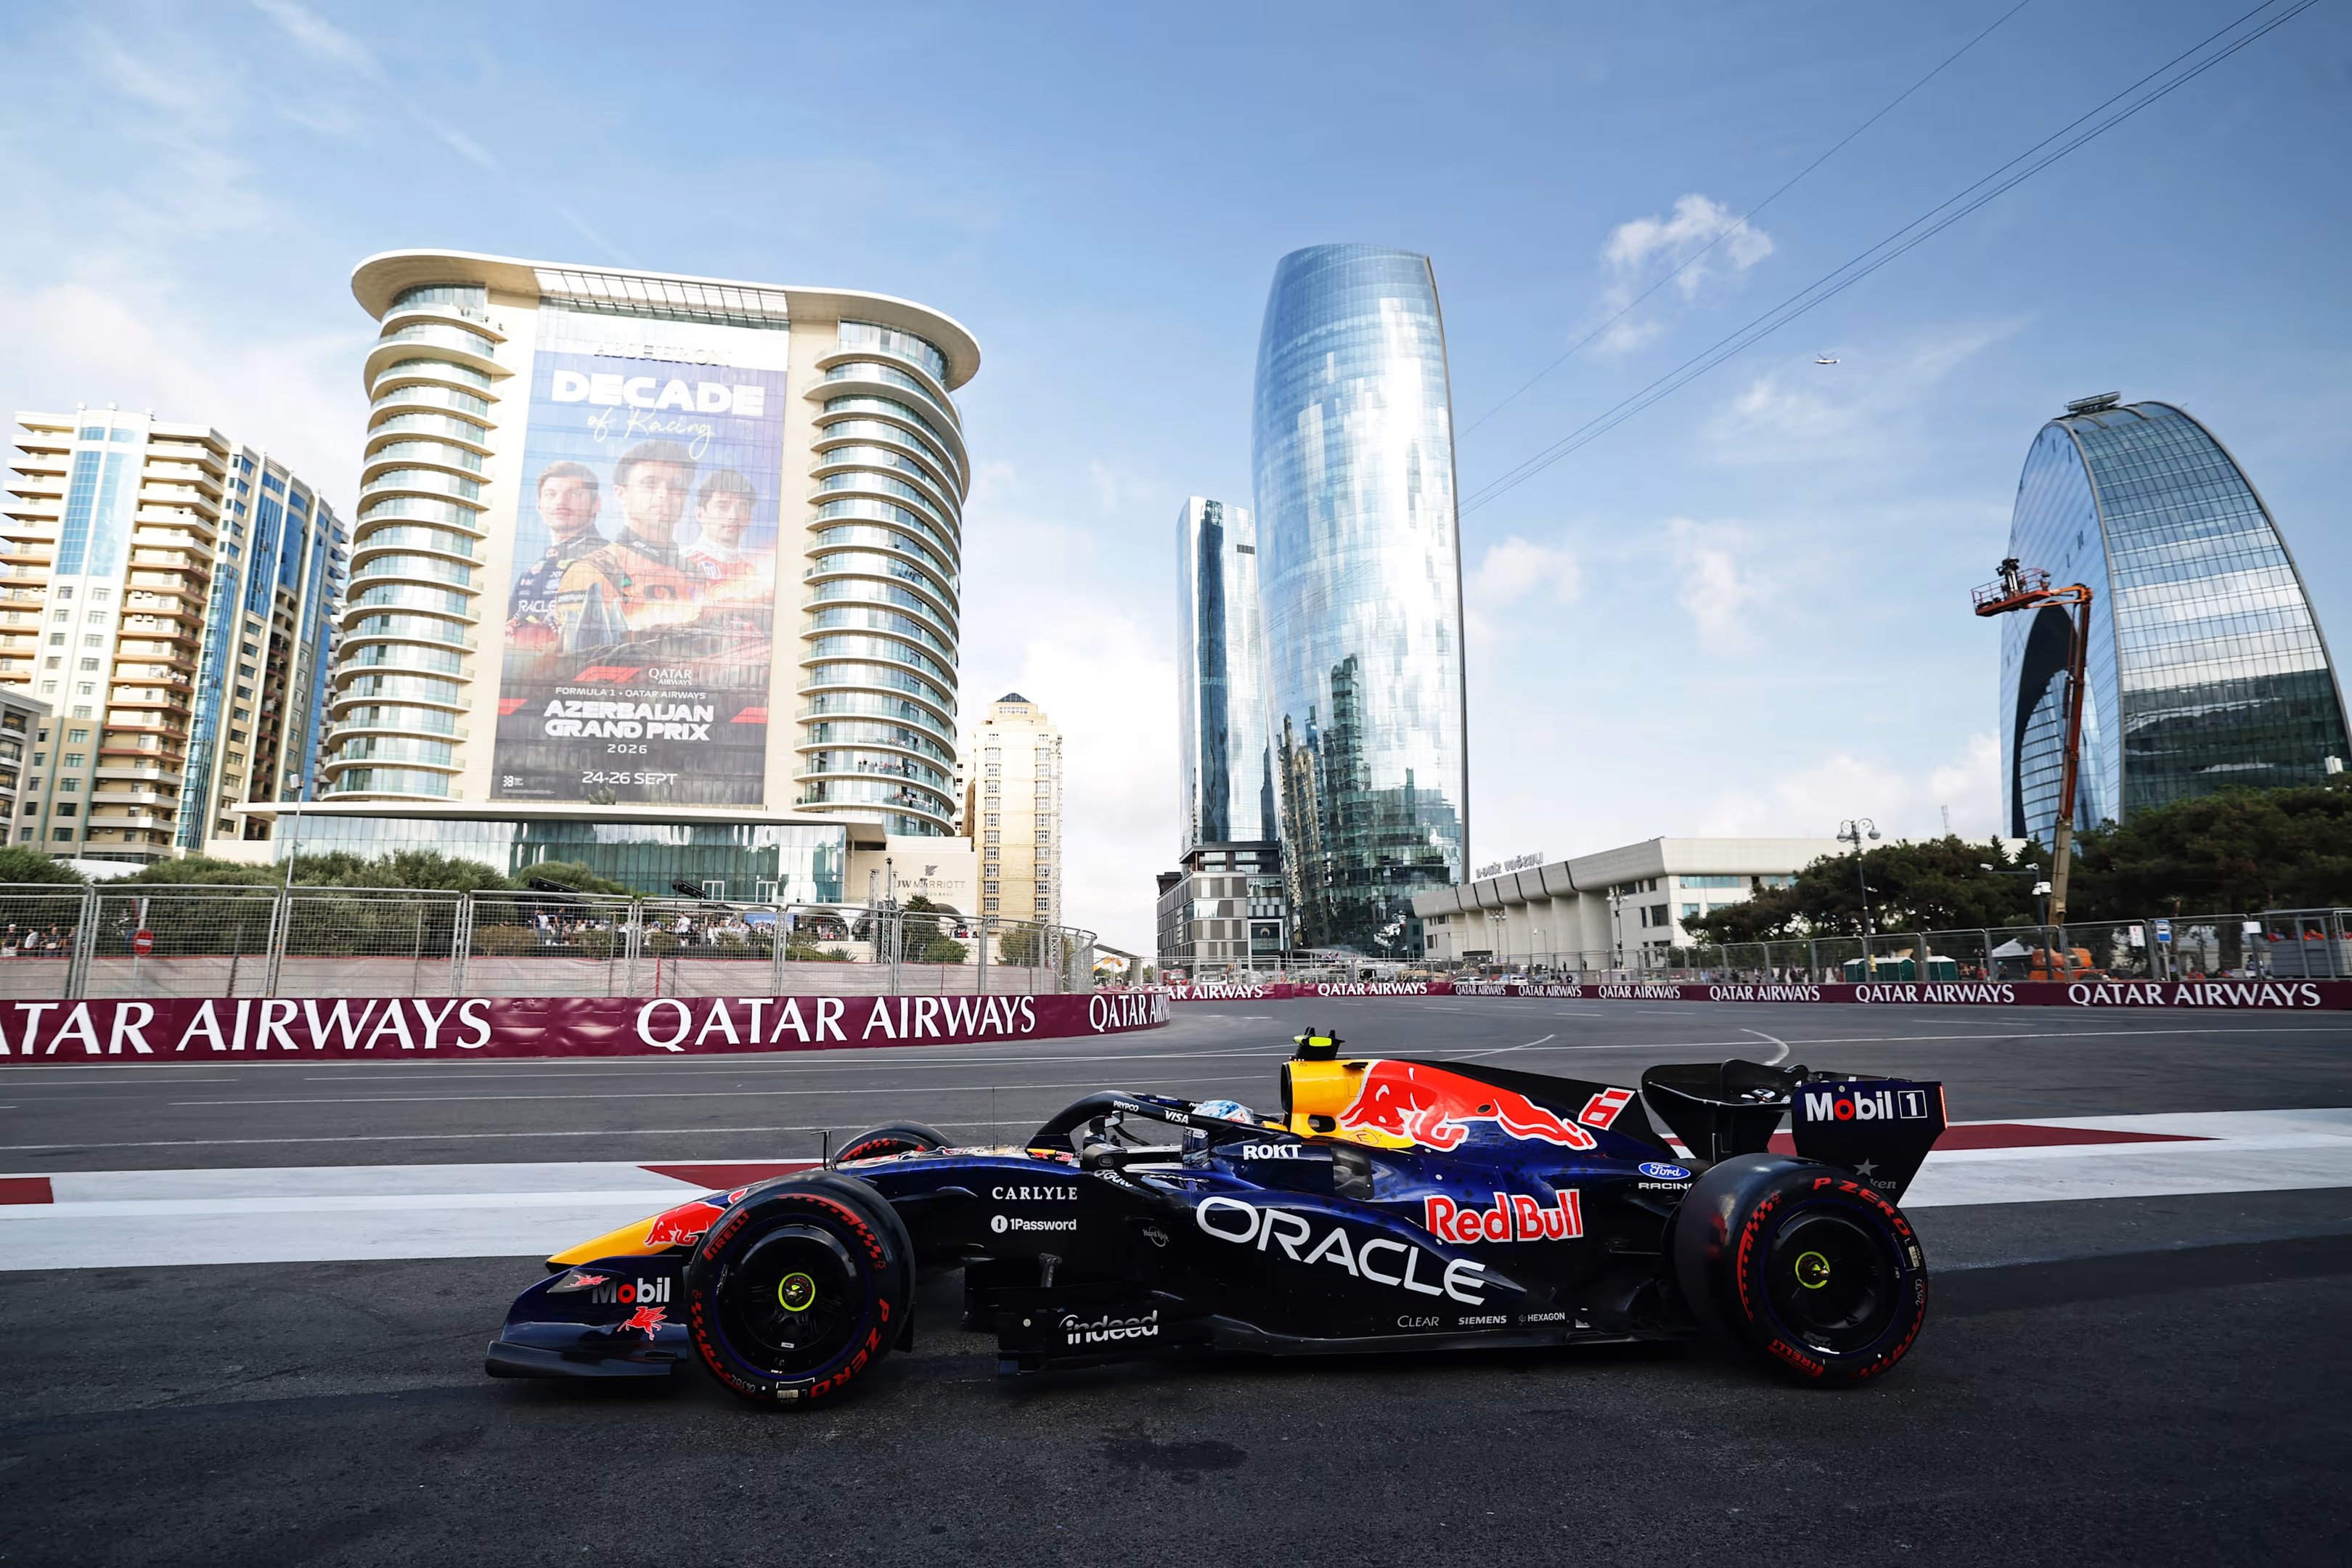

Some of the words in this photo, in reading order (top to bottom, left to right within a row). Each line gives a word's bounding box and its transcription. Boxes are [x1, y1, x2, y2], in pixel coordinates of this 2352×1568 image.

[552, 369, 765, 417] DECADE
[587, 407, 616, 442] of
[625, 405, 715, 460] Racing
[648, 668, 692, 679] QATAR
[555, 687, 607, 696] FORMULA
[625, 689, 658, 698] QATAR
[661, 691, 706, 700] AIRWAYS
[544, 700, 714, 722] AZERBAIJAN
[544, 719, 643, 738] GRAND
[646, 722, 711, 741] PRIX
[607, 743, 648, 754] 2026
[581, 771, 630, 784] 24-26
[634, 772, 678, 785] SEPT
[1191, 984, 1264, 999] AIRWAYS
[1318, 984, 1365, 997] QATAR
[1369, 982, 1428, 995] AIRWAYS
[1455, 984, 1477, 996] QATAR
[1479, 985, 1507, 996] AIRWAYS
[1518, 985, 1545, 997] QATAR
[1546, 985, 1582, 997] AIRWAYS
[1598, 986, 1631, 999] QATAR
[1635, 986, 1681, 999] AIRWAYS
[1709, 985, 1754, 1002] QATAR
[1757, 985, 1821, 1002] AIRWAYS
[1855, 984, 1919, 1004] QATAR
[1923, 984, 2015, 1004] AIRWAYS
[2068, 982, 2165, 1007] QATAR
[2173, 983, 2322, 1007] AIRWAYS
[1089, 995, 1147, 1032] QATAR
[1150, 994, 1169, 1024] AIRW
[0, 1003, 154, 1055] TAR
[176, 999, 492, 1050] AIRWAYS
[636, 998, 848, 1052] QATAR
[862, 995, 1037, 1040] AIRWAYS
[1113, 1100, 1140, 1112] PRYPCO
[1577, 1087, 1636, 1130] 6
[1805, 1092, 1893, 1122] Mobil
[1904, 1093, 1918, 1116] 1
[1164, 1109, 1189, 1124] VISA
[1244, 1144, 1302, 1160] ROKT
[1649, 1164, 1681, 1177] Ford
[992, 1187, 1077, 1200] CARLYLE
[1424, 1191, 1512, 1243] Red
[1512, 1189, 1584, 1242] Bull
[1813, 1177, 1832, 1191] P
[1838, 1180, 1911, 1236] ZERO
[702, 1207, 750, 1261] PIRELLI
[1010, 1218, 1077, 1230] 1Password
[1196, 1196, 1485, 1305] ORACLE
[592, 1277, 671, 1304] Mobil
[879, 1298, 890, 1322] P
[1458, 1315, 1507, 1325] SIEMENS
[1527, 1312, 1565, 1322] HEXAGON
[1066, 1310, 1159, 1345] indeed
[1397, 1315, 1440, 1328] CLEAR
[810, 1327, 881, 1398] ZERO
[1767, 1339, 1824, 1377] PIRELLI
